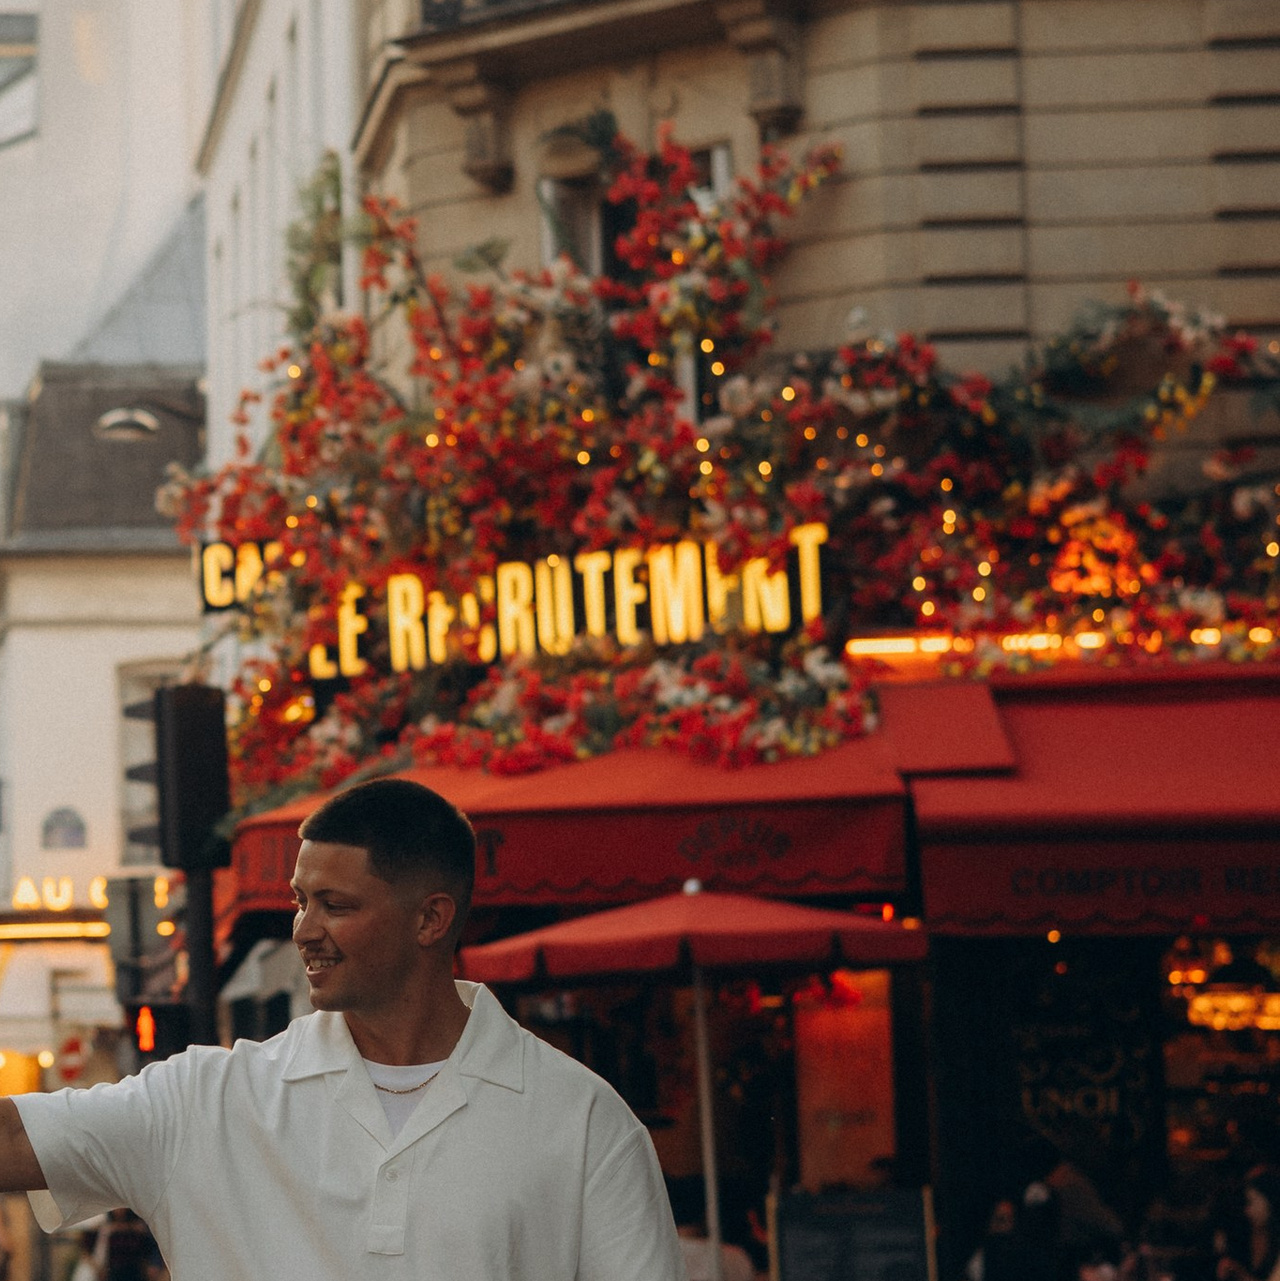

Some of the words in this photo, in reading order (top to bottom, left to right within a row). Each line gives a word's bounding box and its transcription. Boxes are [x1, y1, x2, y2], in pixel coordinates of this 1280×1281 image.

[12, 875, 74, 911] AU
[1009, 866, 1202, 897] COMPTOIR
[1223, 866, 1280, 897] RE
